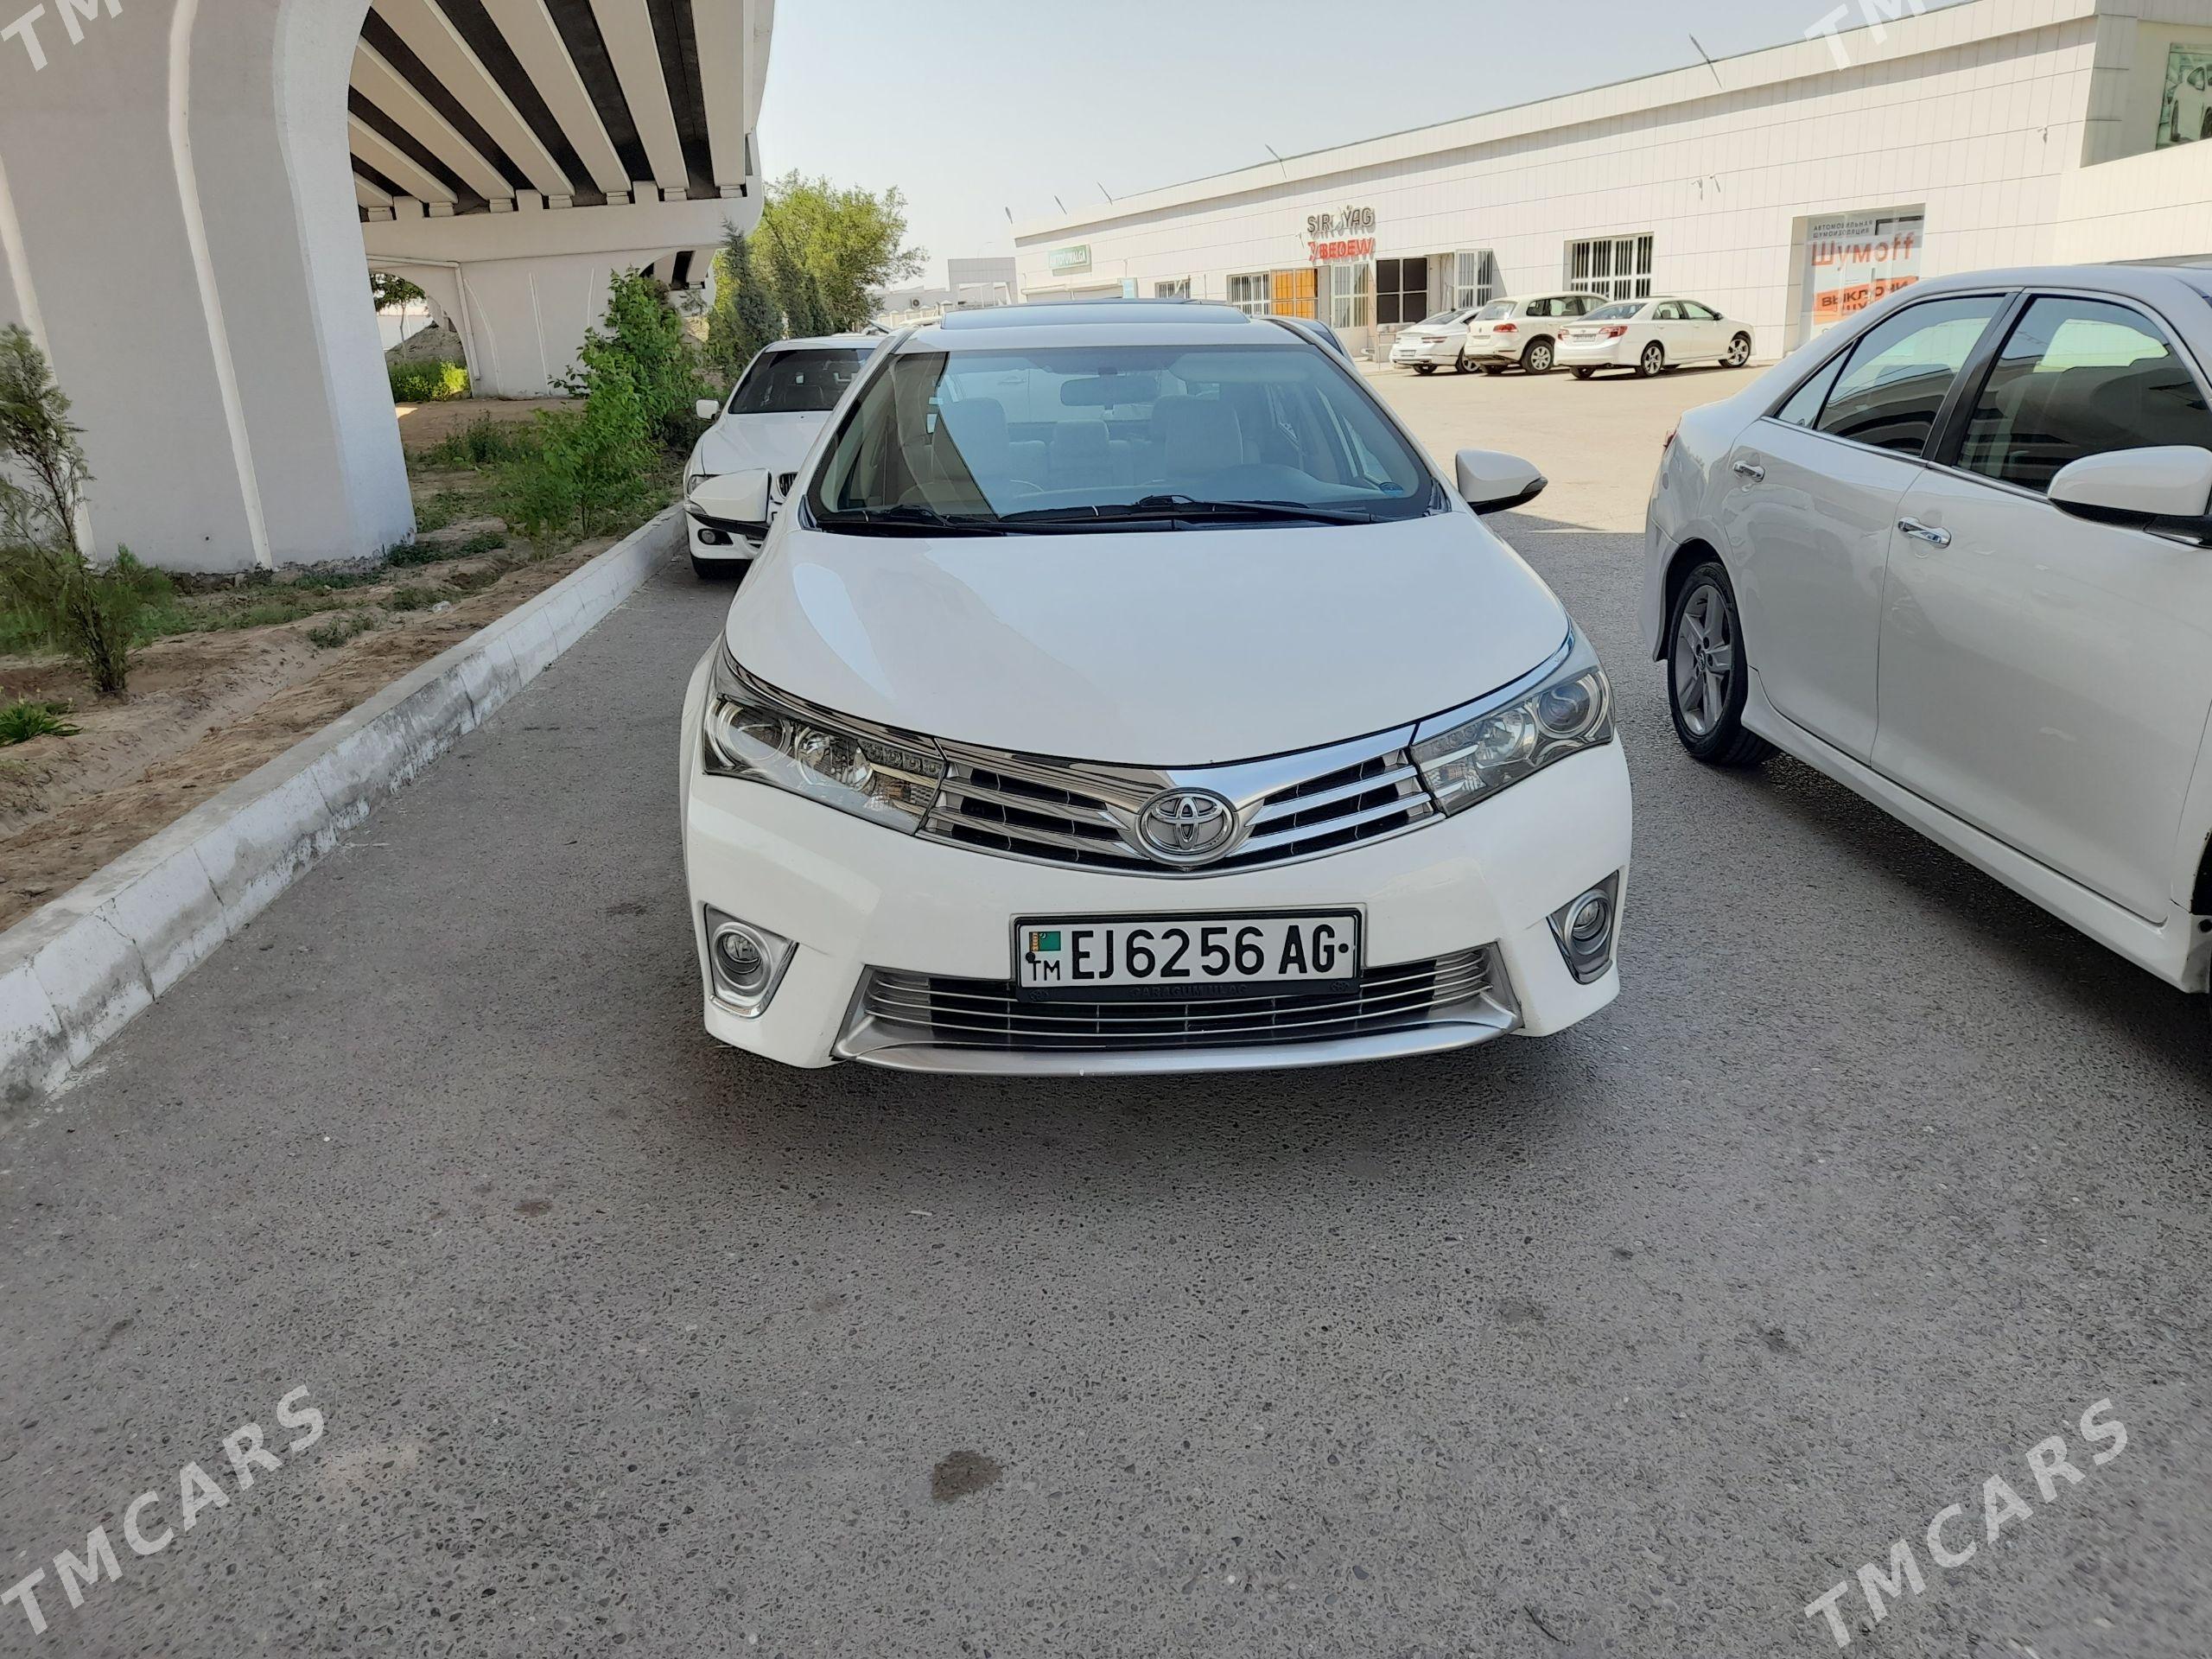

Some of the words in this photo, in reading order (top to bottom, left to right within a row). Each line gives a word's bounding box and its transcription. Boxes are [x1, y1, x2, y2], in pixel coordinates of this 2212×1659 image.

[1319, 238, 1372, 259] BEDEW
[1278, 924, 1336, 975] AG
[1029, 959, 1061, 982] TM
